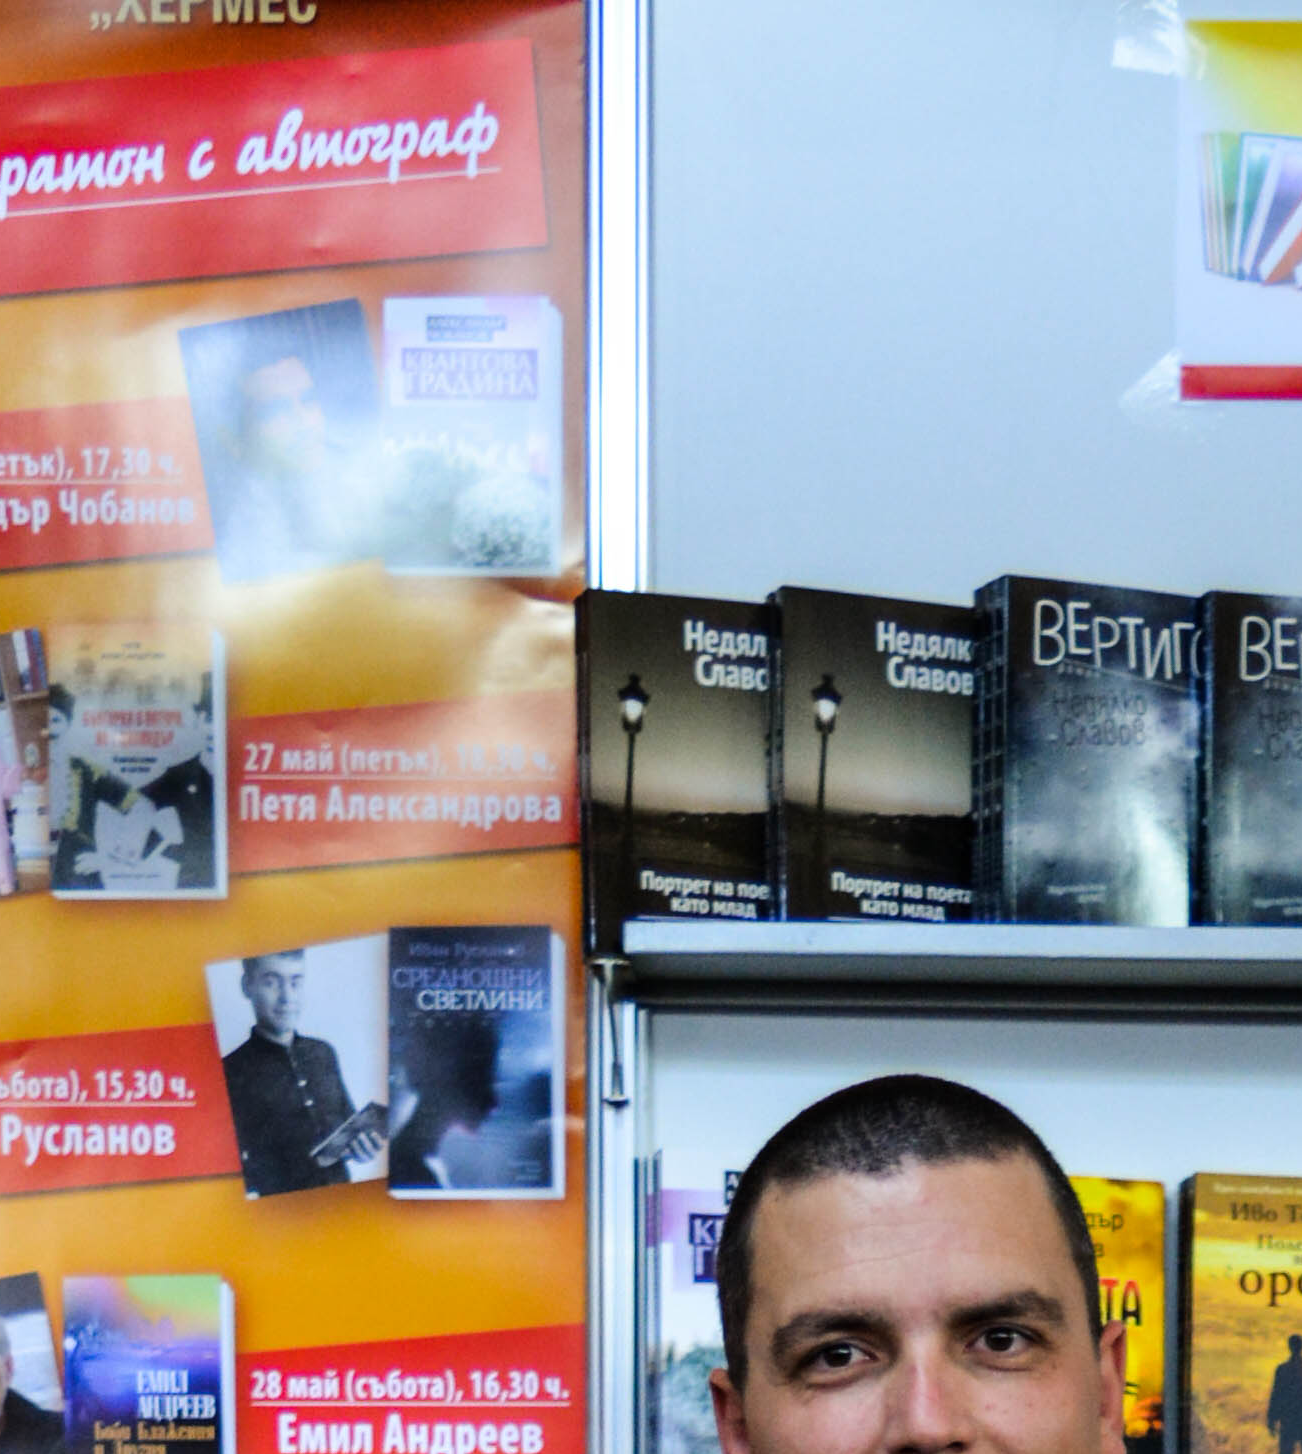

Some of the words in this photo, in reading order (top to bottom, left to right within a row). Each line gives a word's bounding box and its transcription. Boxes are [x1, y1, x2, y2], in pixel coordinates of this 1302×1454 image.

[58, 489, 195, 526] Чобанов
[239, 786, 316, 822] Петя
[325, 785, 561, 829] Александрова
[831, 872, 900, 897] Портрет
[903, 882, 923, 898] на
[0, 1113, 175, 1161] Русланов
[1231, 1202, 1280, 1222] Иво
[252, 1371, 281, 1399] 28
[288, 1368, 339, 1398] май
[346, 1367, 463, 1402] (събота),
[471, 1368, 539, 1400] 16,30
[545, 1374, 569, 1396] ч.
